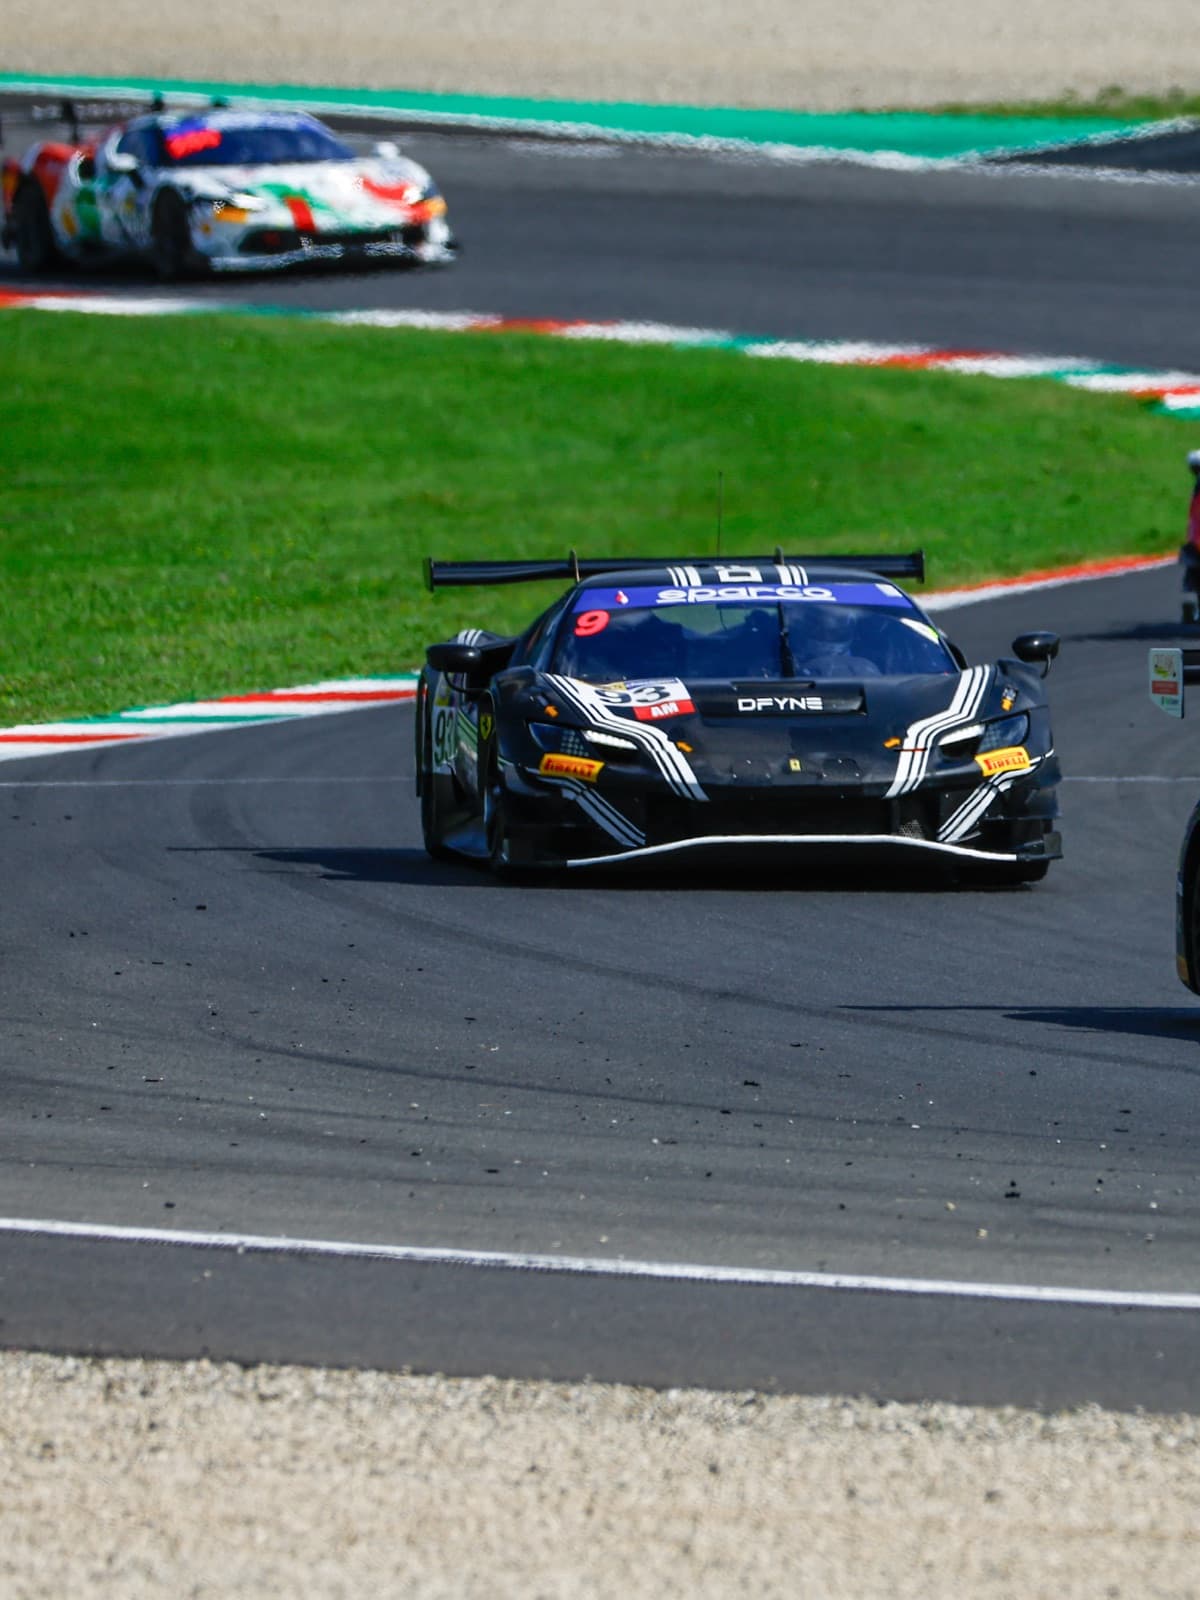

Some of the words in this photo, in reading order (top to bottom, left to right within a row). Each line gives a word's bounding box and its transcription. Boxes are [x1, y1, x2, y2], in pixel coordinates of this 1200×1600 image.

[657, 586, 836, 604] sparco
[573, 609, 611, 637] 9
[594, 685, 671, 704] 93
[650, 701, 680, 718] AM
[737, 697, 824, 712] DFYNE
[984, 750, 1027, 771] PIRELLI
